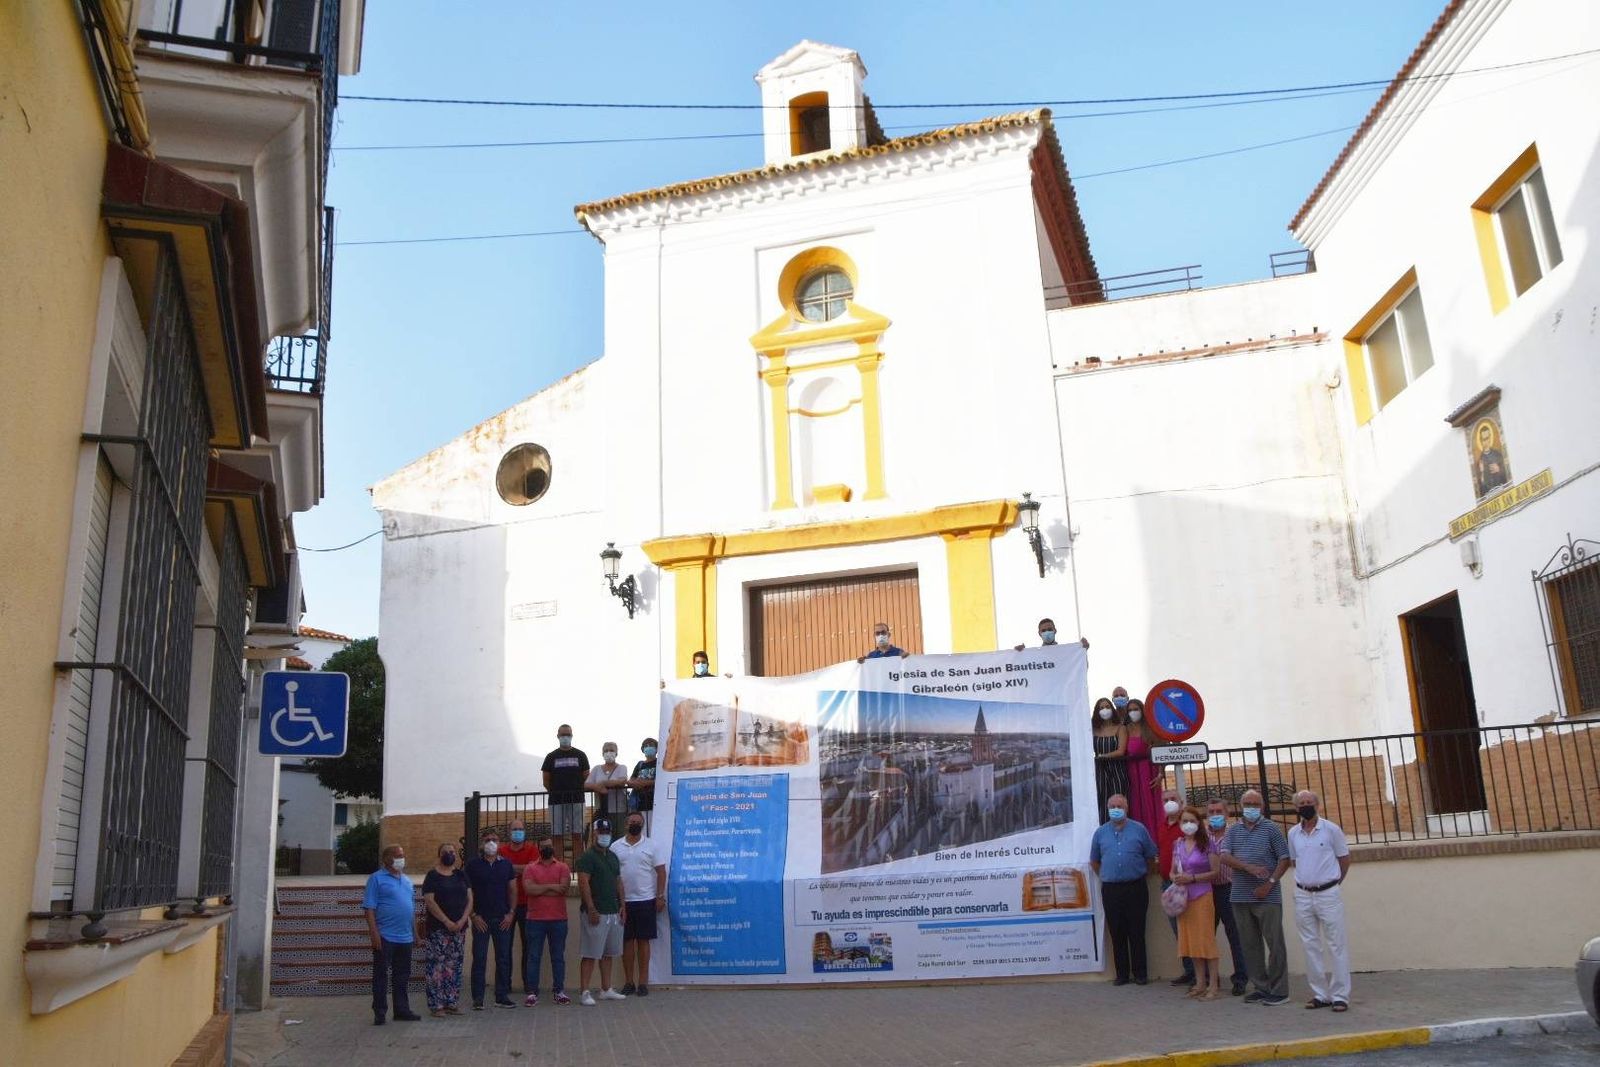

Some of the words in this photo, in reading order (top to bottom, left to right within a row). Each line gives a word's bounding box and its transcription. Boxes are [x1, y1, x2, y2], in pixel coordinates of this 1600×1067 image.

[888, 670, 927, 681] Iglesia
[931, 668, 944, 678] de
[948, 668, 970, 677] San
[974, 666, 1002, 675] Juan
[1006, 661, 1055, 672] Bautista
[912, 682, 968, 694] Gibraleón
[972, 680, 1002, 692] (siglo
[1005, 678, 1028, 688] XIV)
[1168, 721, 1174, 729] 4
[1155, 754, 1205, 762] PERMANENTE
[935, 852, 956, 861] Bien
[960, 850, 972, 860] de
[976, 848, 1010, 859] Interés
[1014, 845, 1054, 856] Cultural
[811, 910, 822, 920] Tu
[824, 910, 850, 922] ayuda
[852, 910, 862, 919] es
[865, 905, 930, 920] imprescindible
[932, 906, 952, 918] para
[954, 901, 1009, 914] conservarla
